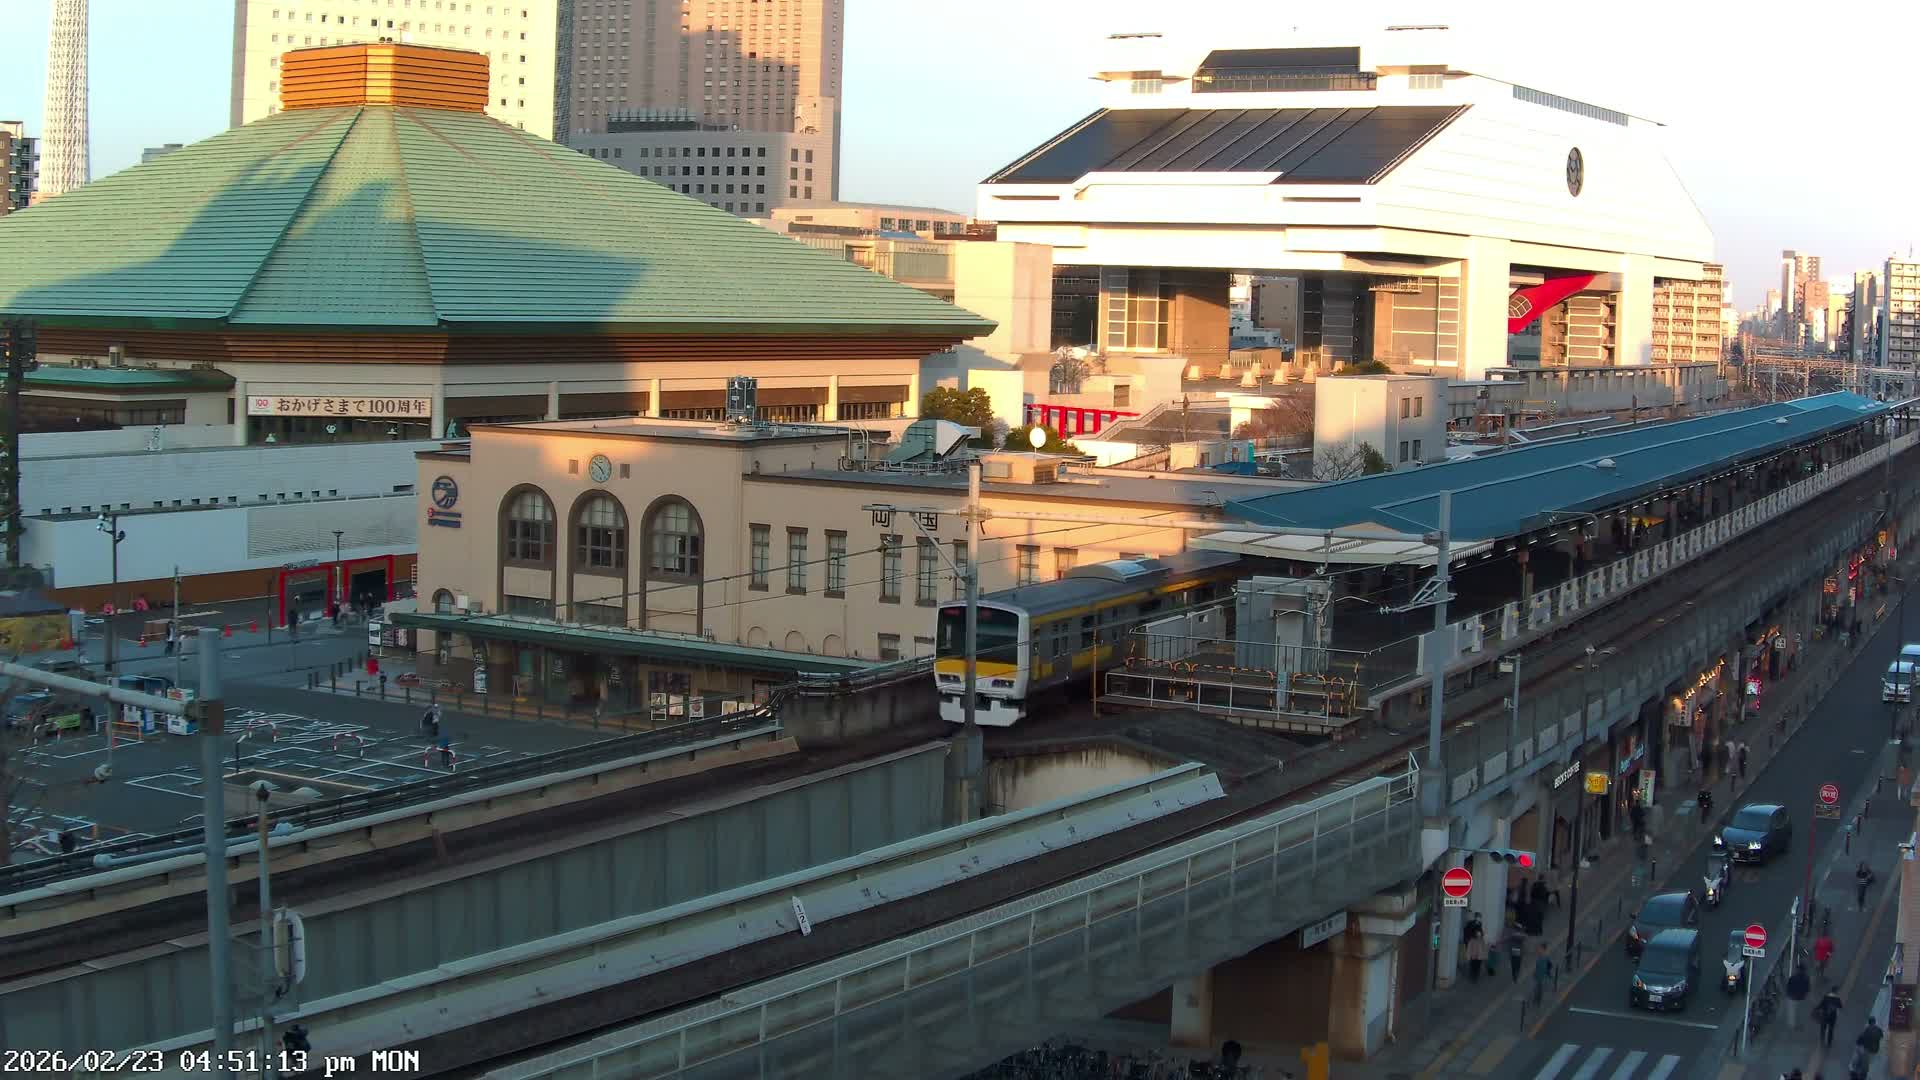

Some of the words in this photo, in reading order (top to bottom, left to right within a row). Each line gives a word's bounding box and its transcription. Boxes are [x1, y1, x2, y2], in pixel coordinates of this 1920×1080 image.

[277, 398, 426, 414] おかげさまで100周年
